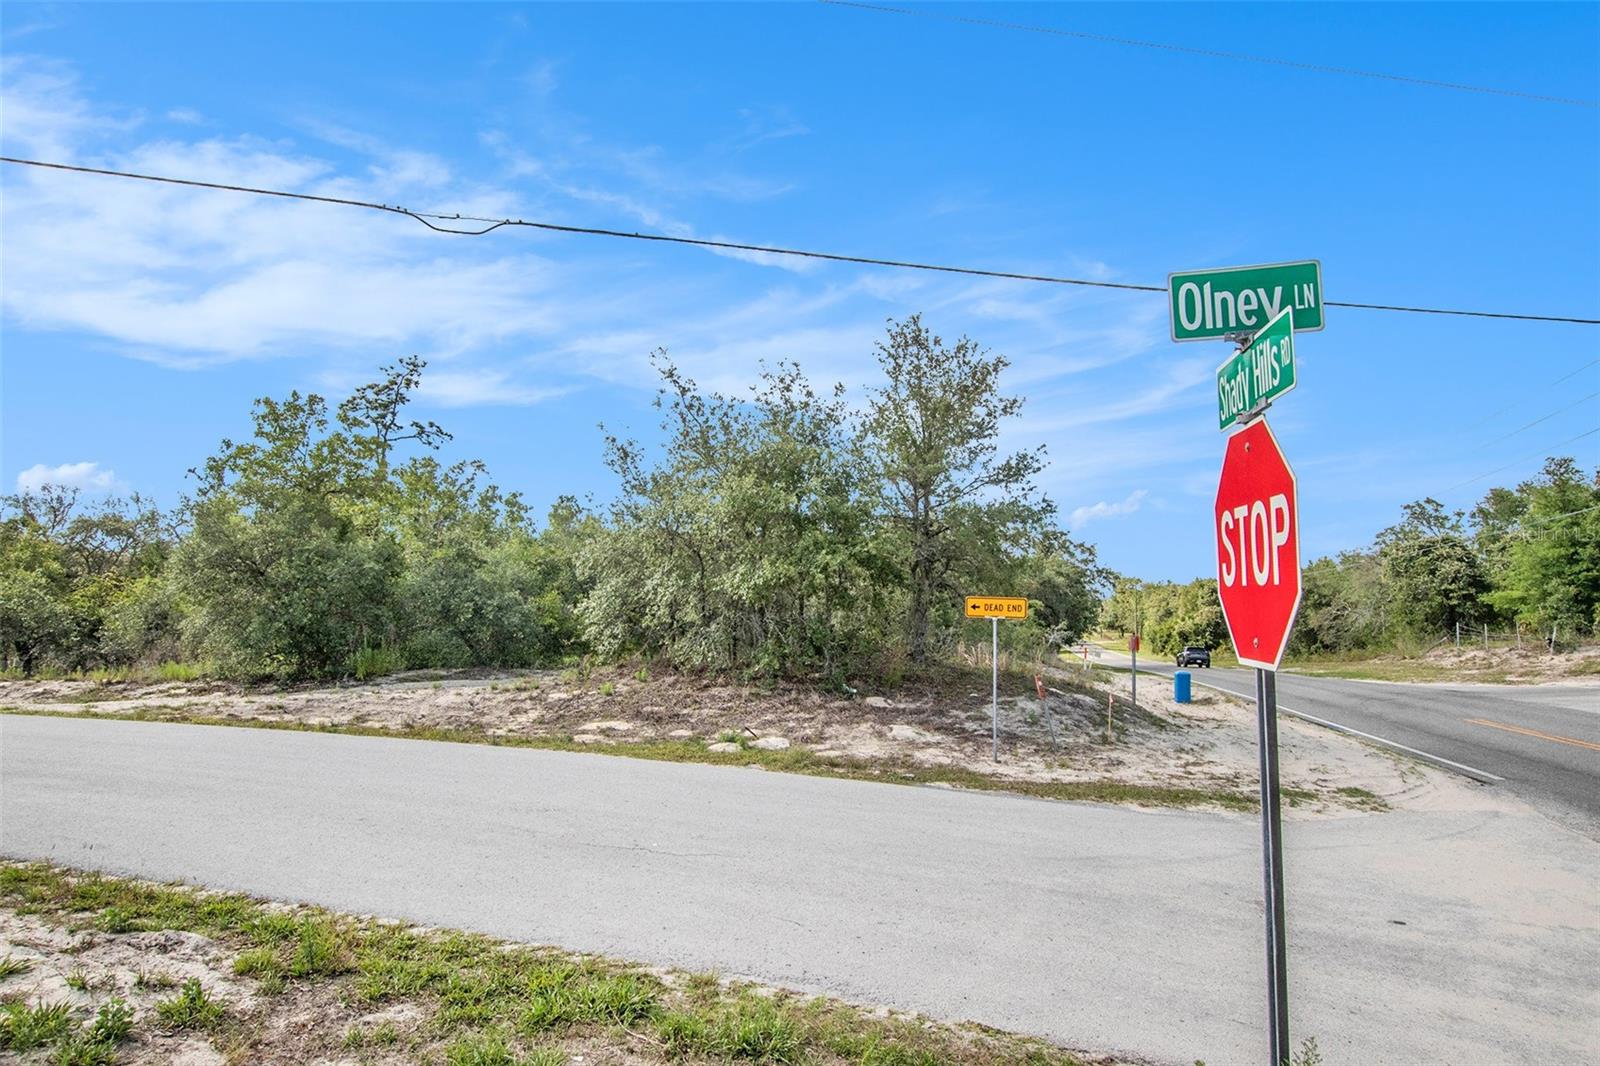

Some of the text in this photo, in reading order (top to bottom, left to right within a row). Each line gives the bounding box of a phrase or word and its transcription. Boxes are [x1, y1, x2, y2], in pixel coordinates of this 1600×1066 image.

[1178, 281, 1315, 331] Olney LN
[1219, 336, 1291, 421] Shady Hills RD
[1220, 493, 1290, 587] STOP
[984, 603, 1023, 612] DEAD END
